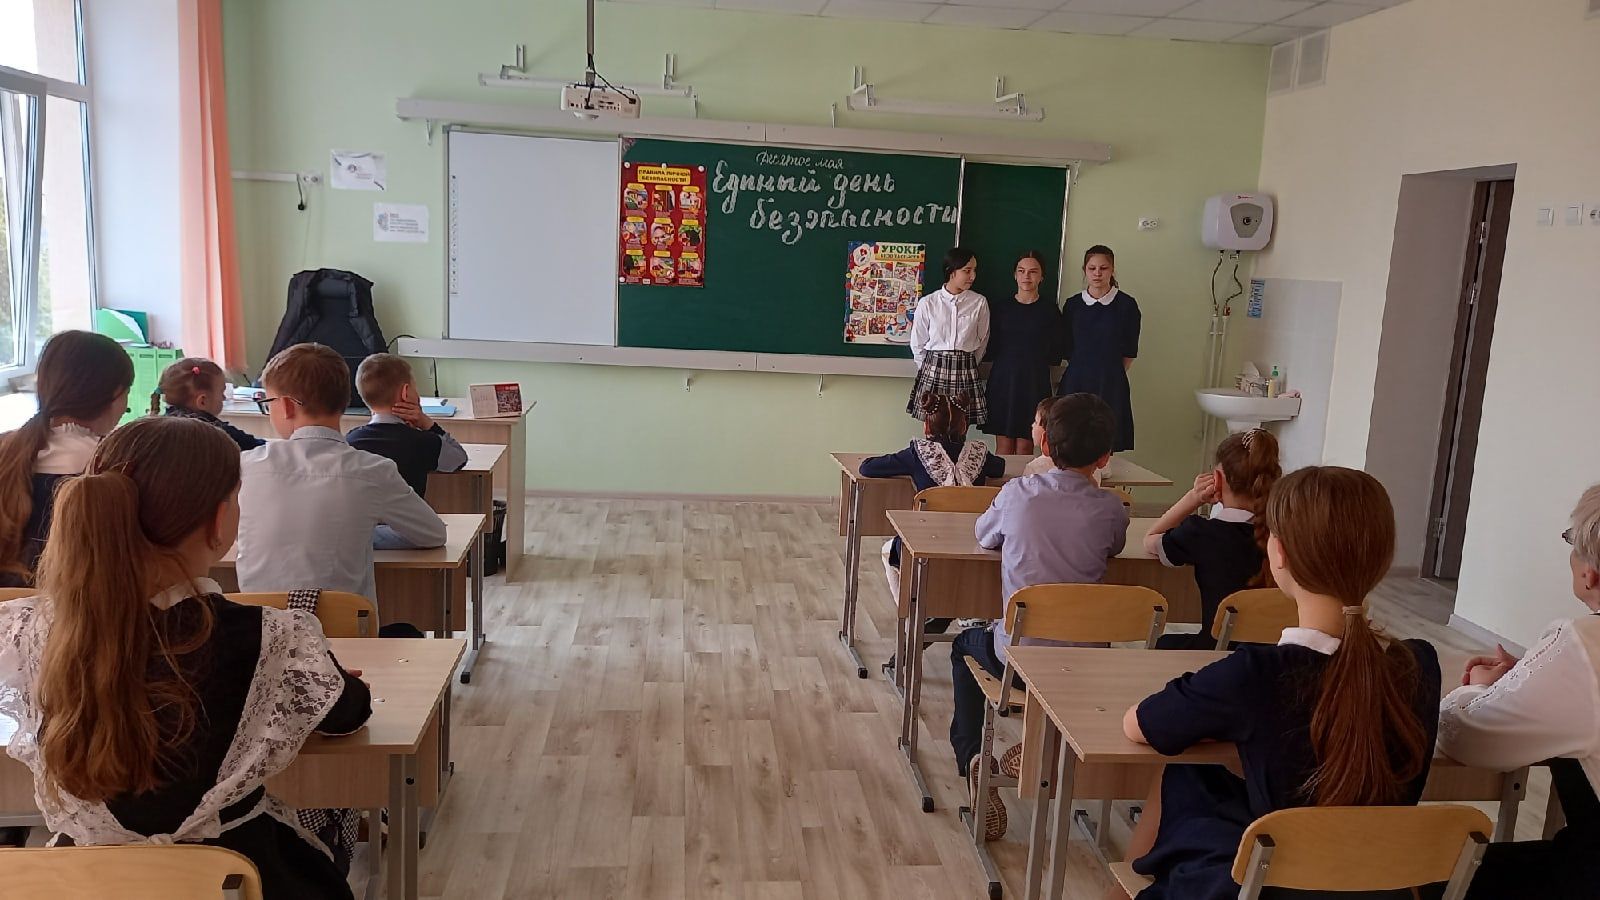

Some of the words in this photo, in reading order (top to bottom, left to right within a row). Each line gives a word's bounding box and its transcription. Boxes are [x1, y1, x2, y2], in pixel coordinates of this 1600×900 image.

[712, 159, 822, 214] Единый
[827, 172, 896, 209] день
[815, 157, 844, 170] мая
[749, 197, 958, 245] безопасности
